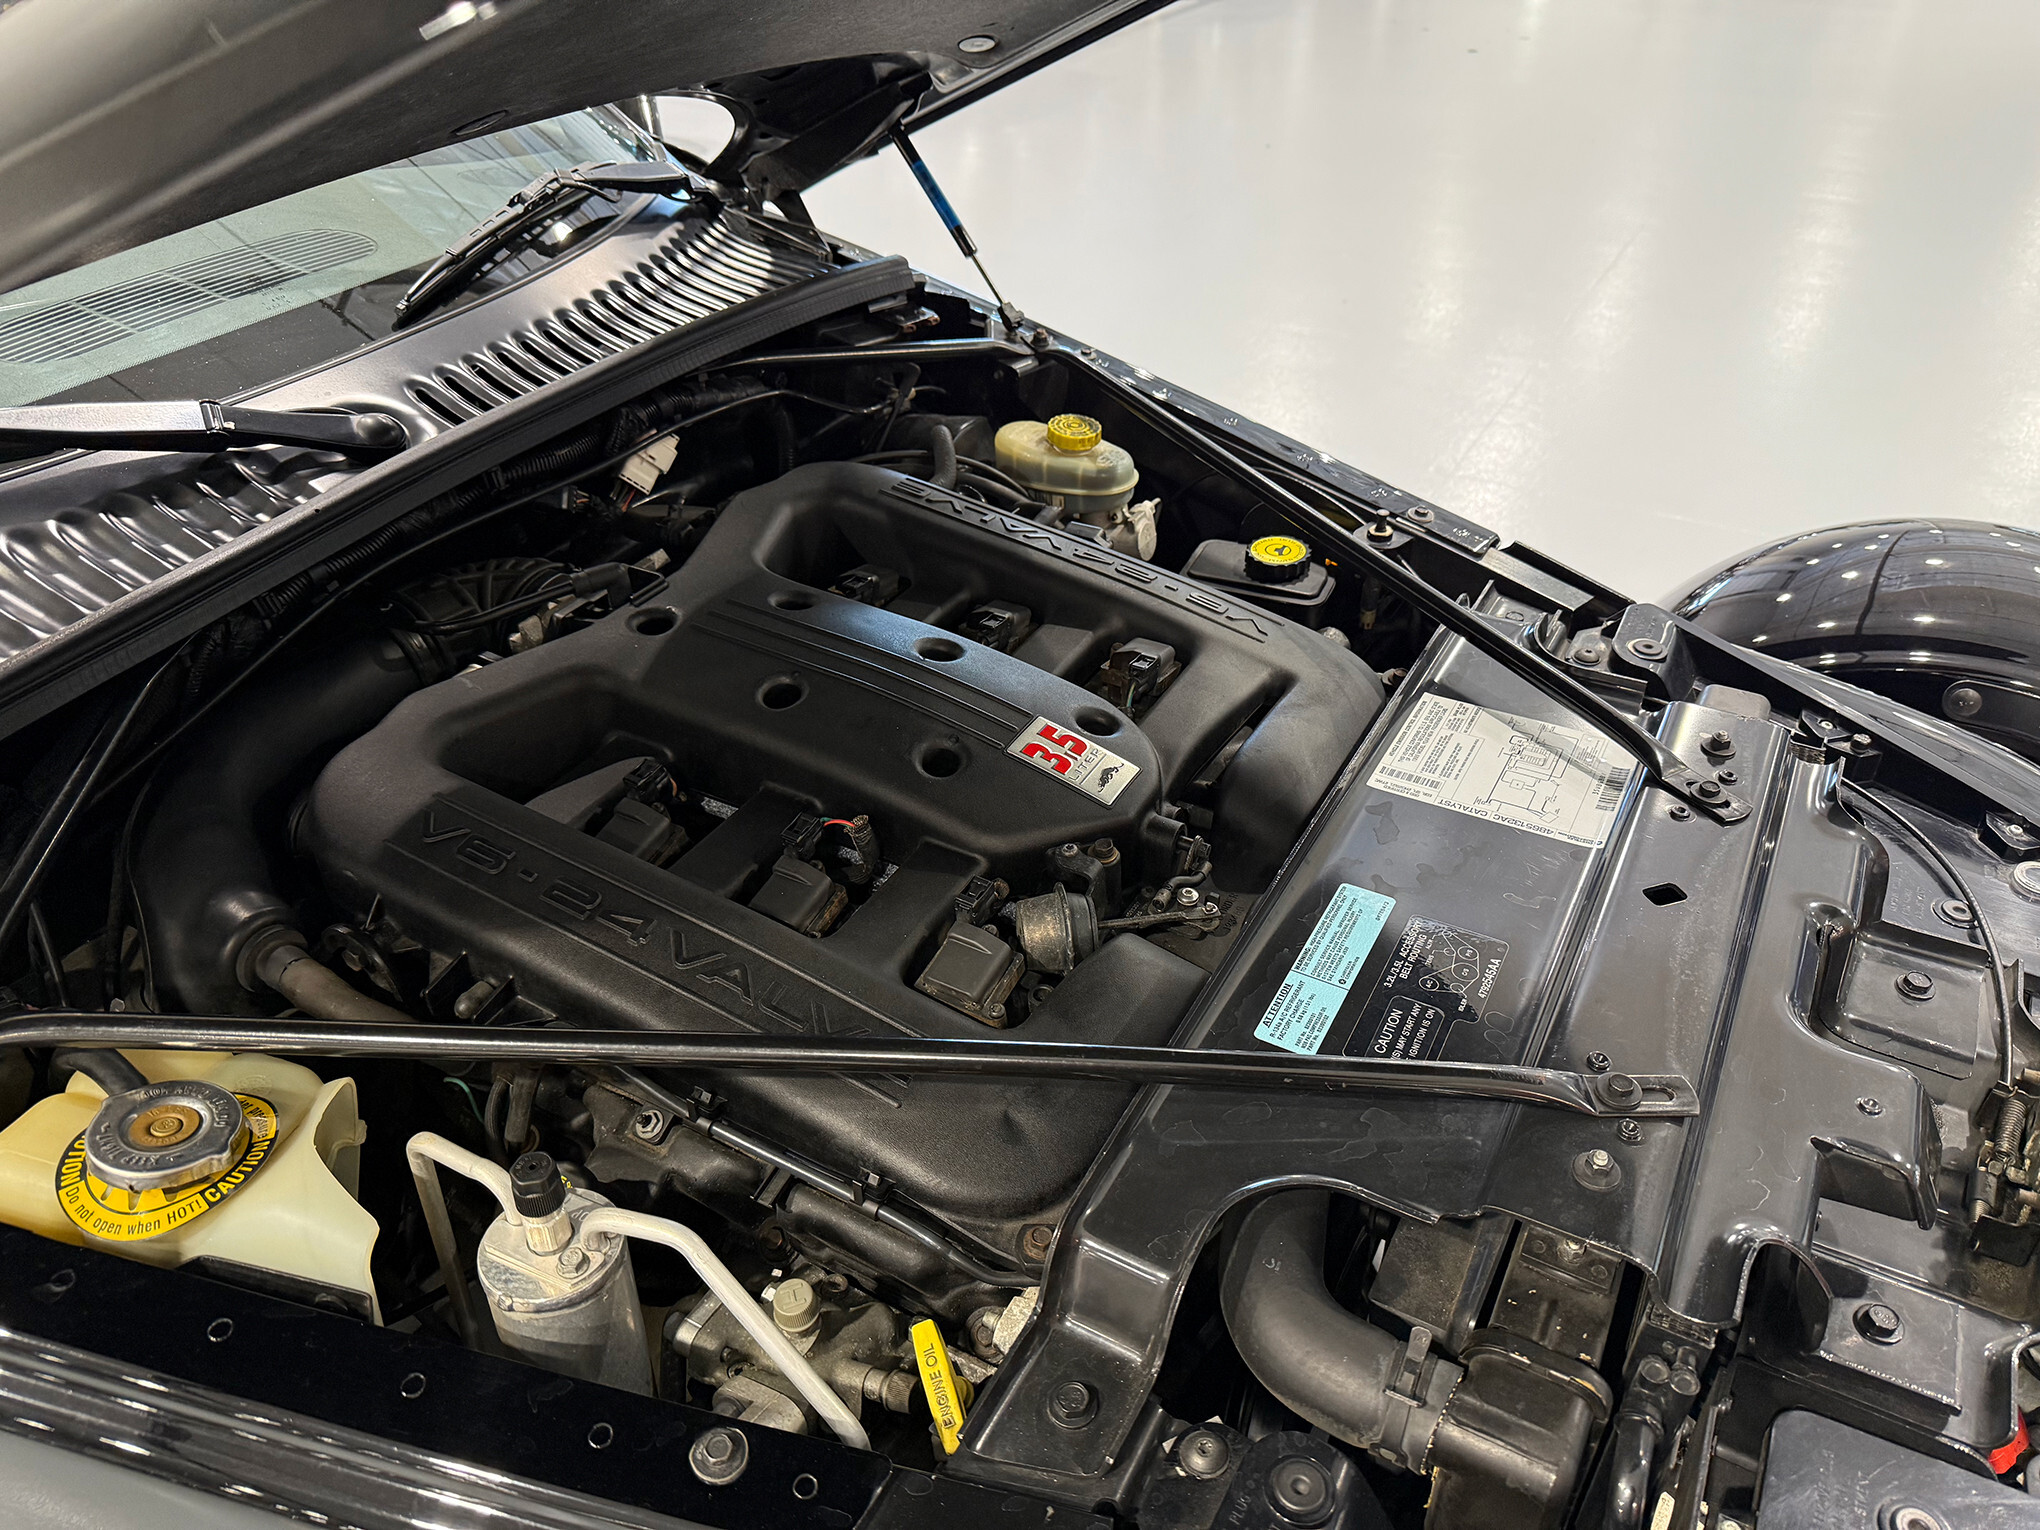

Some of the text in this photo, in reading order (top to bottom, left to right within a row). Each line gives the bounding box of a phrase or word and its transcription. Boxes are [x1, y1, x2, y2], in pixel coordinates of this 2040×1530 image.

[1069, 748, 1103, 782] LITER
[1437, 798, 1488, 817] CATALYST
[1382, 919, 1424, 988] 3.2L/3.5L ACCESSORY
[1399, 933, 1428, 979] BELT ROUTING
[1260, 982, 1292, 1026] ATTENTION
[1282, 979, 1306, 1012] REFRIGERANT
[1408, 1002, 1423, 1017] ANY
[1276, 997, 1305, 1040] FACTORY CHARGE
[1371, 1007, 1406, 1054] CAUTION
[1400, 1015, 1418, 1036] START
[1420, 1018, 1432, 1027] IS
[1424, 1008, 1436, 1019] ON
[1393, 1035, 1409, 1050] MAY
[1408, 1026, 1428, 1057] IGNITION
[205, 1140, 270, 1202] CAUTION
[65, 1186, 202, 1236] Do not open when HOT!
[923, 1342, 956, 1430] ENGINE OIL
